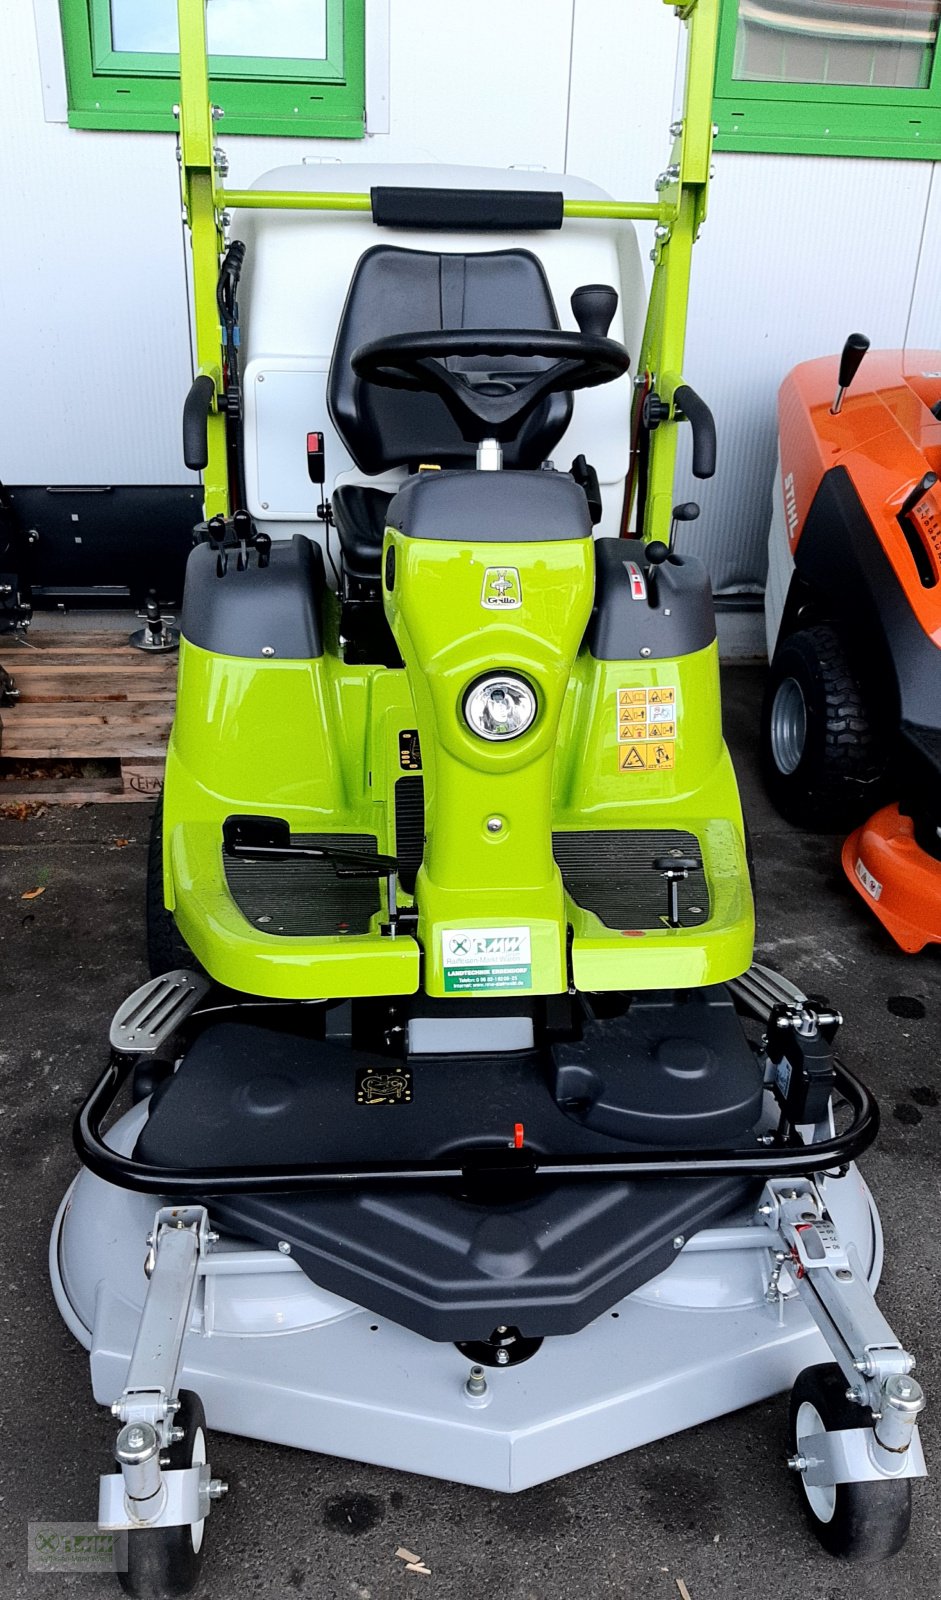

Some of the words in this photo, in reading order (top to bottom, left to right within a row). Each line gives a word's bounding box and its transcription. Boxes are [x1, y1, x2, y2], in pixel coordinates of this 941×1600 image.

[784, 472, 799, 538] STIHL
[473, 937, 527, 953] RMW
[447, 969, 491, 977] LANDTECHNIK
